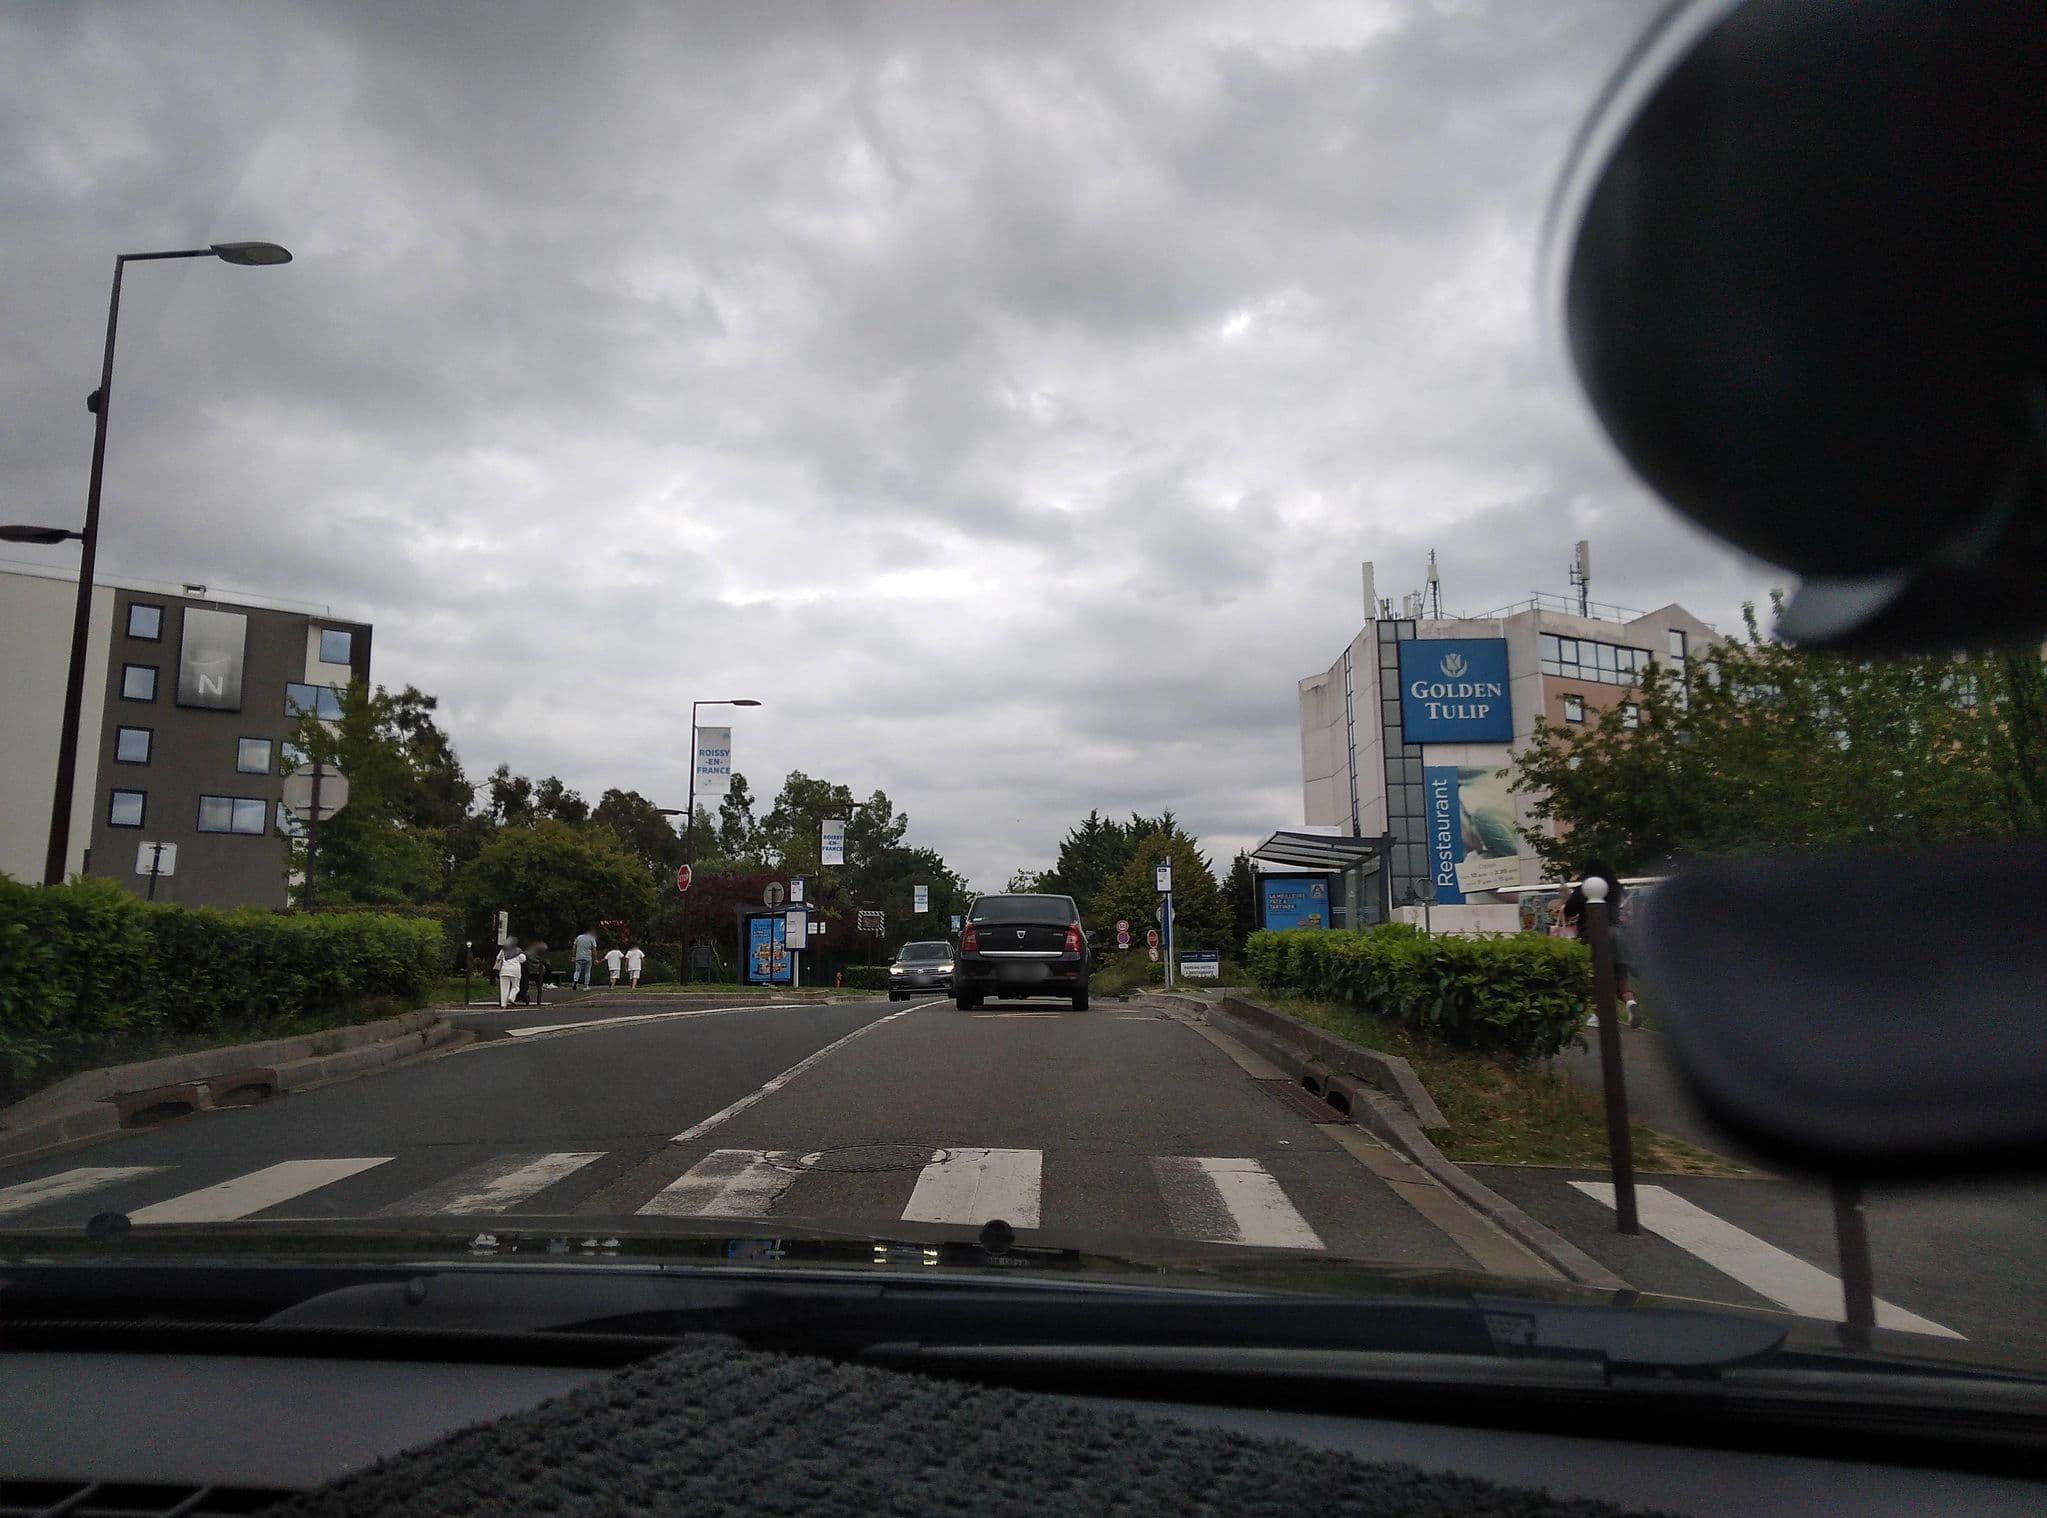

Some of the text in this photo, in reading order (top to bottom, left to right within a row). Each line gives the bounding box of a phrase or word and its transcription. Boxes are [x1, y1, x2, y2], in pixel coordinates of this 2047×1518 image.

[198, 673, 223, 695] N
[1411, 681, 1502, 698] GOLDEN
[1425, 703, 1489, 719] TULIP
[1432, 779, 1454, 886] Restaurant
